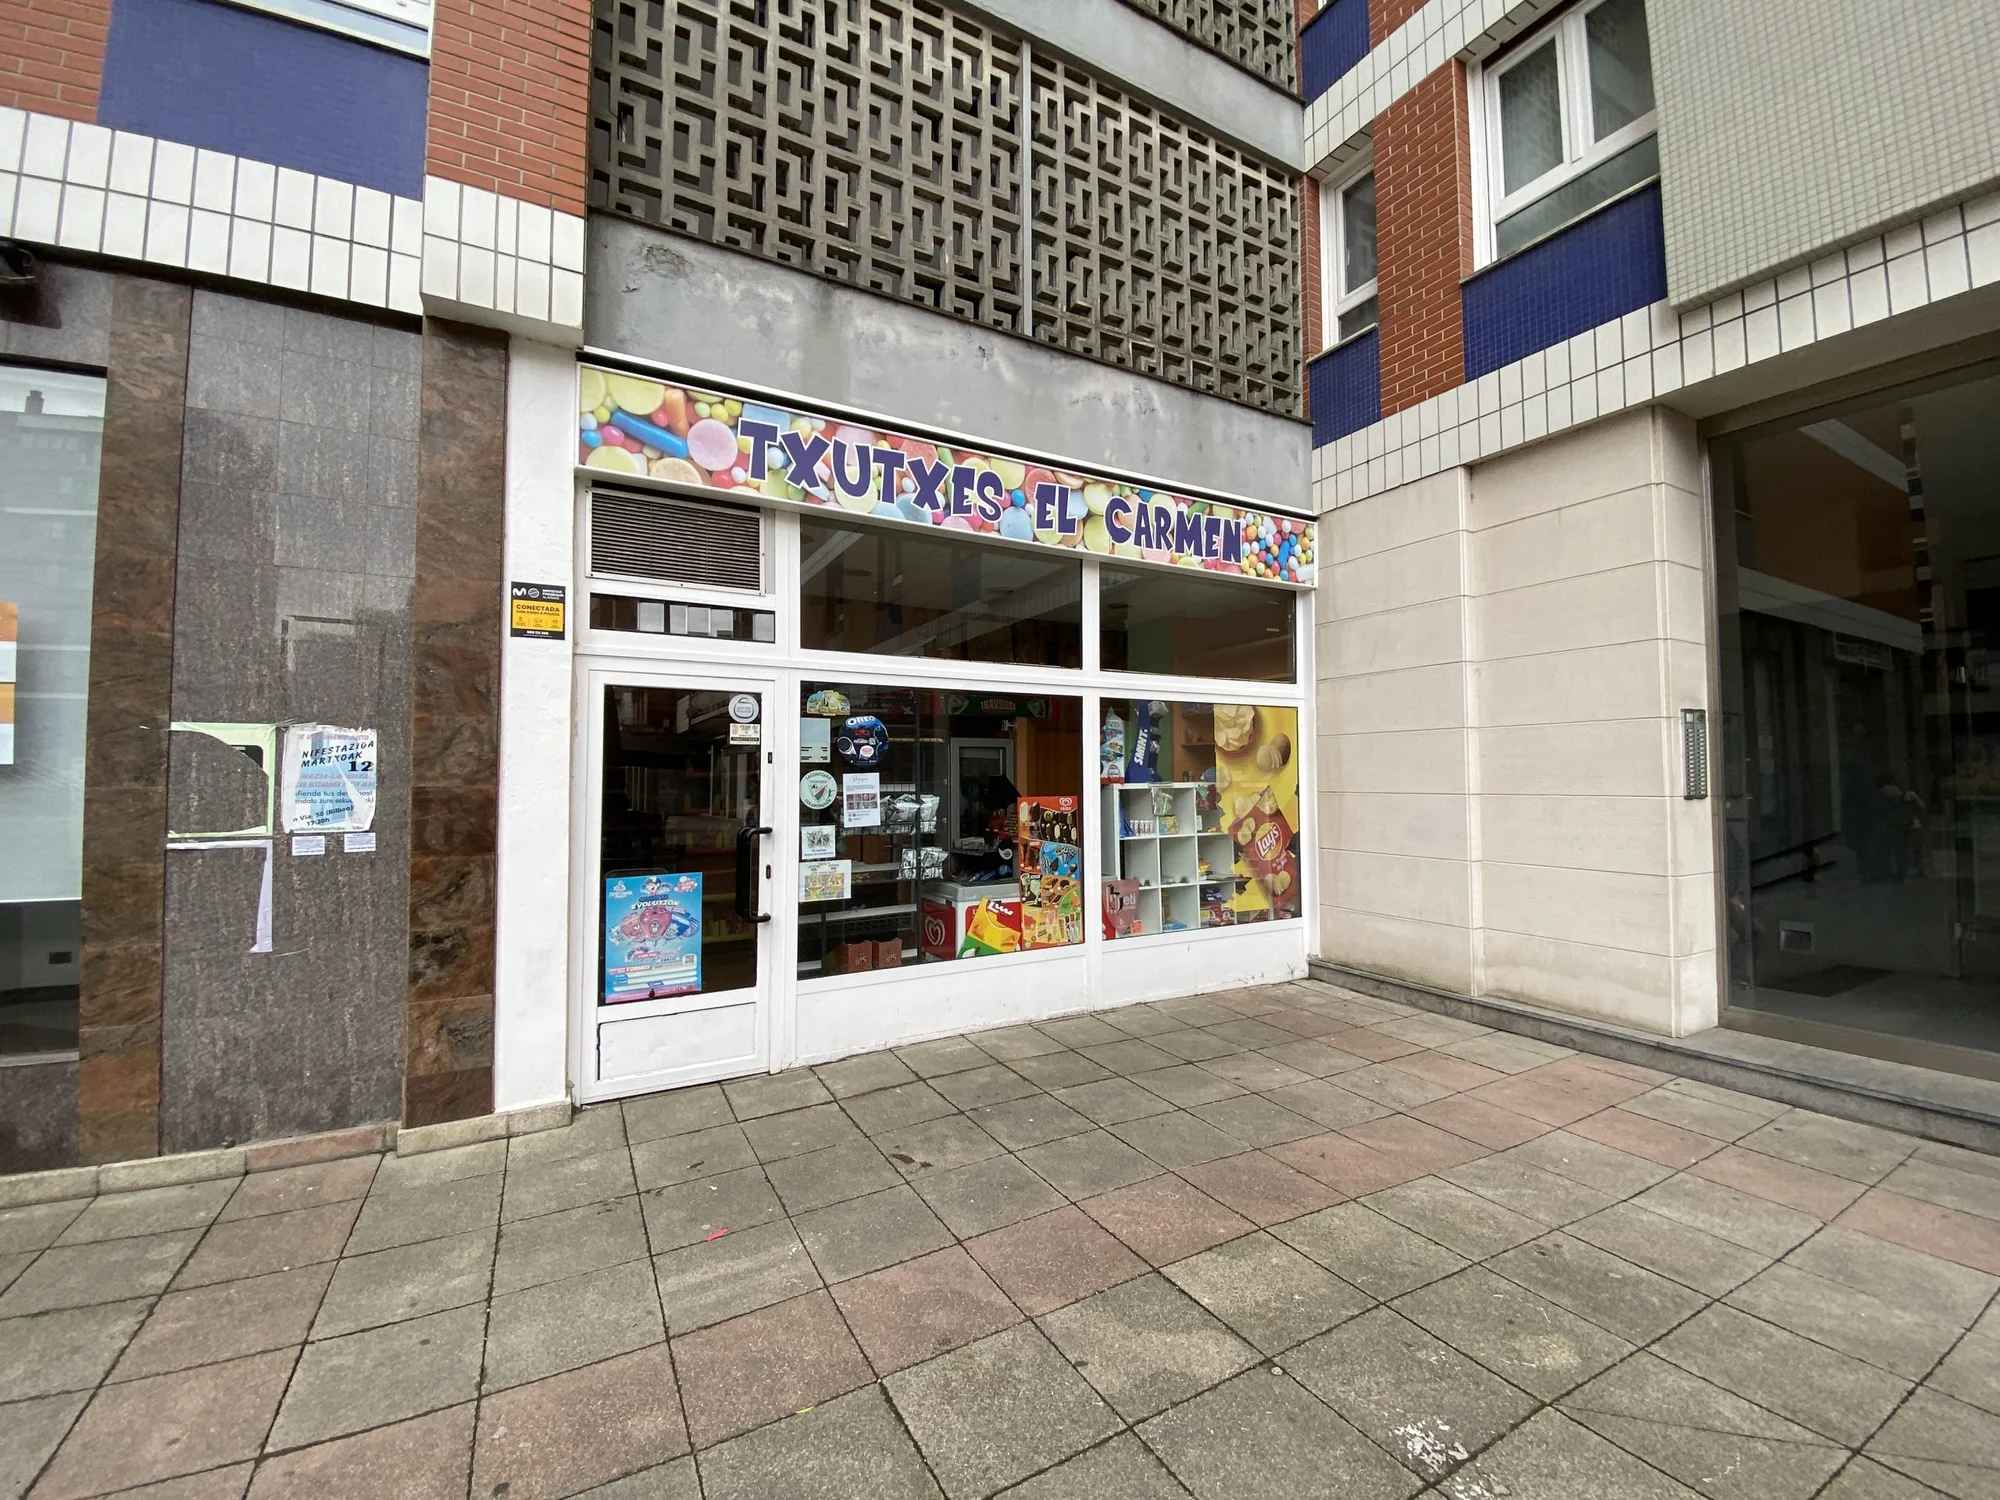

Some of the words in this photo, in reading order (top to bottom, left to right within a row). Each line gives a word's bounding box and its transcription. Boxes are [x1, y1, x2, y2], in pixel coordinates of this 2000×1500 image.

[738, 417, 1002, 523] TXUTXES
[1034, 482, 1077, 536] EL
[1103, 496, 1243, 565] CARMEN
[516, 604, 560, 612] CONECTADA
[847, 715, 875, 726] OREO
[348, 761, 374, 772] 12
[1257, 825, 1279, 857] Lay's
[631, 899, 680, 910] EVOLUTION
